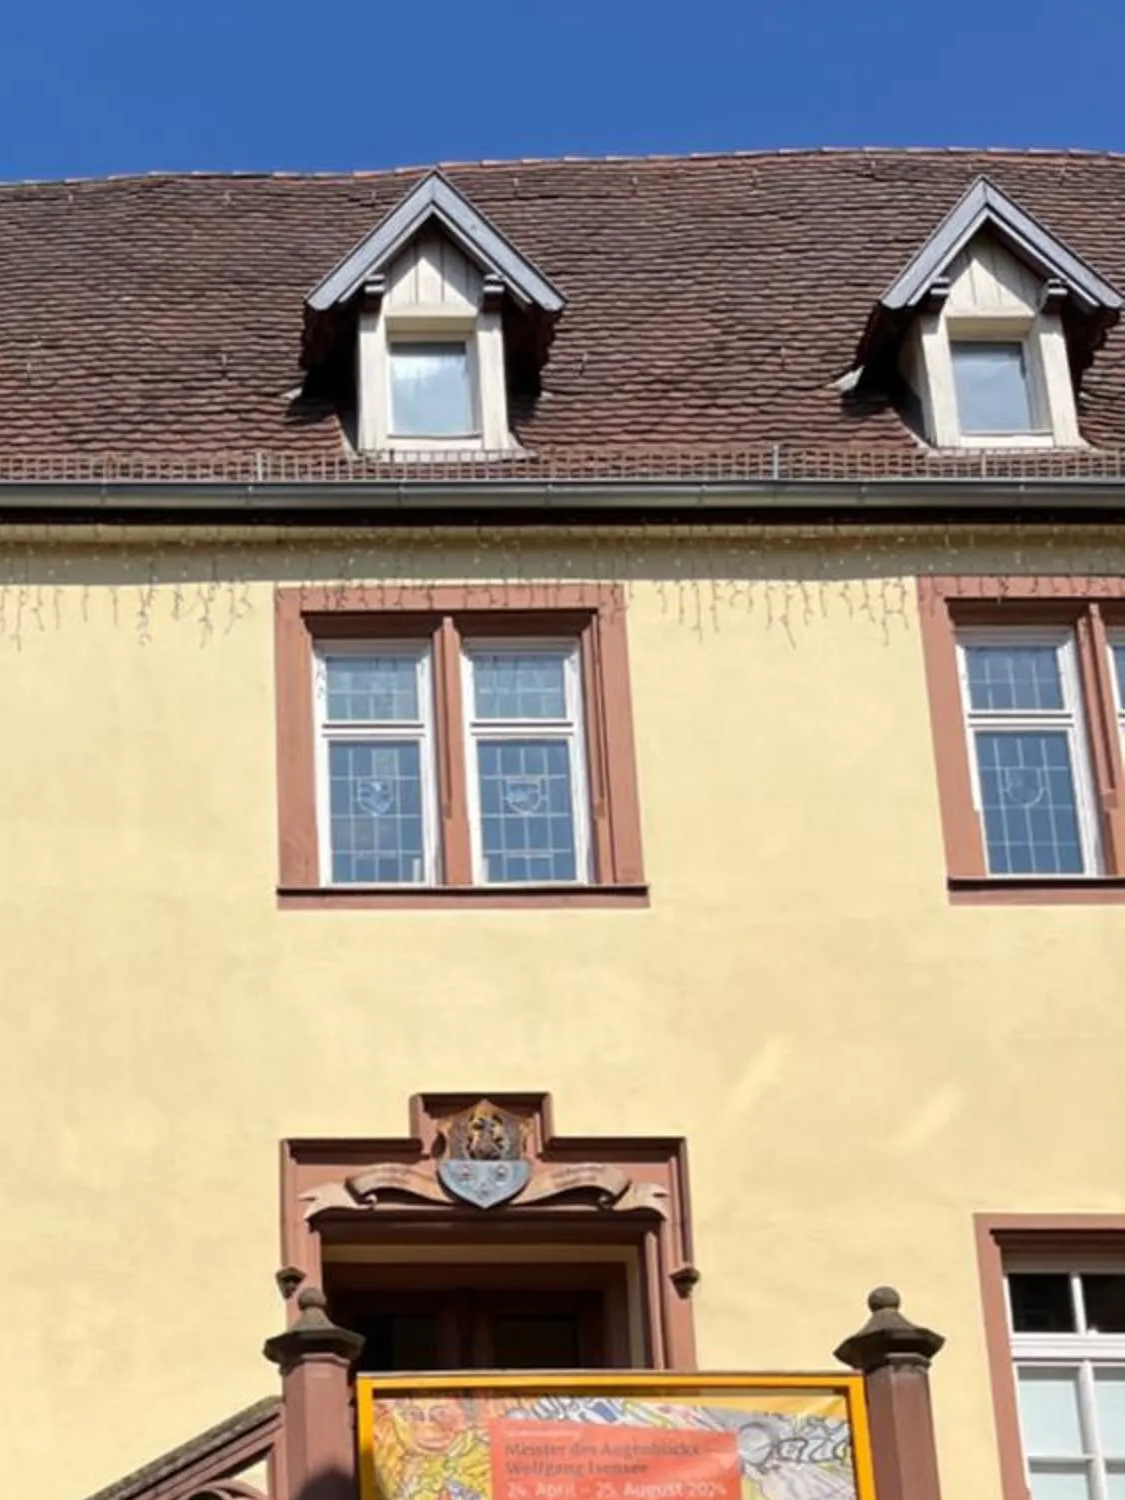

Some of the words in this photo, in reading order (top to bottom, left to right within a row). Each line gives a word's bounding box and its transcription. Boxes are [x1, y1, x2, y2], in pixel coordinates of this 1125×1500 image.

[505, 1442, 565, 1456] Meister
[505, 1460, 584, 1478] Wolfgang
[535, 1481, 576, 1500] April
[596, 1481, 619, 1499] 25.
[622, 1481, 683, 1500] August
[687, 1481, 728, 1498] 2024
